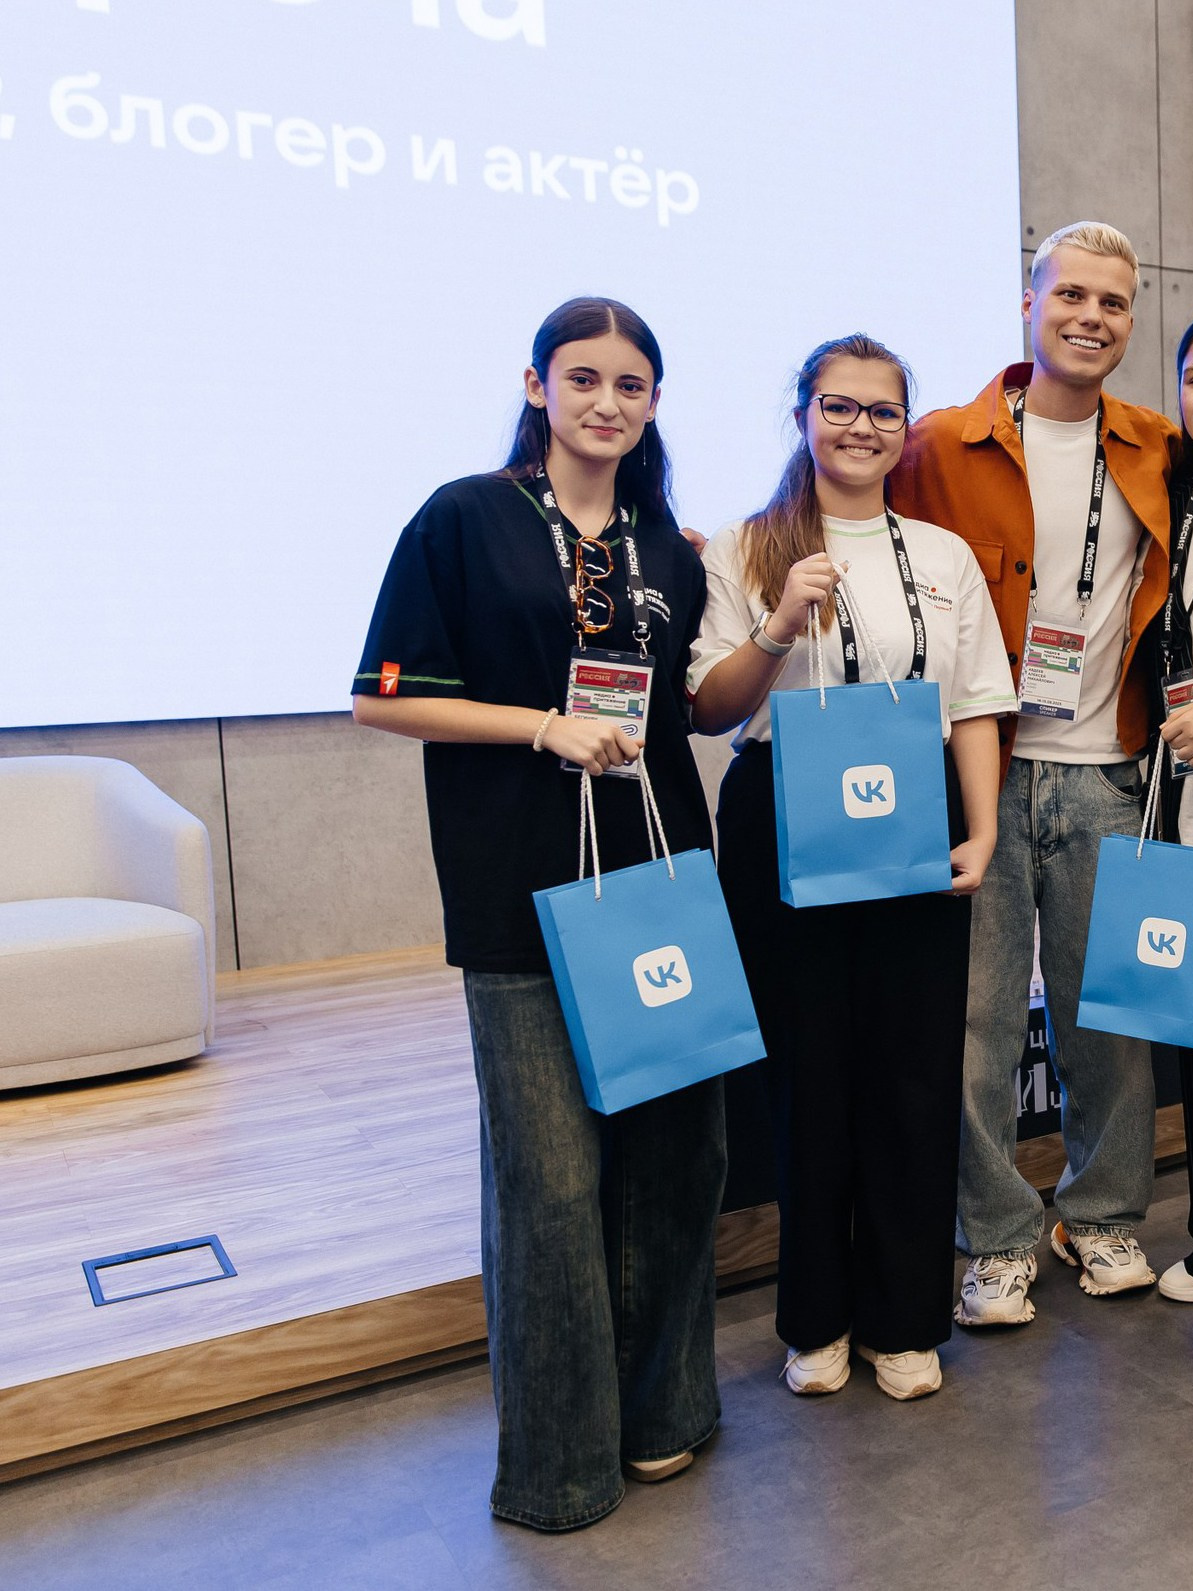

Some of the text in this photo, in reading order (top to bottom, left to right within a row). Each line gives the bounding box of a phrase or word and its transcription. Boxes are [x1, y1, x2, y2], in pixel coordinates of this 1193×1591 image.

[48, 72, 387, 189] блогер
[410, 133, 458, 185] и
[483, 144, 700, 227] актёр
[1093, 460, 1104, 498] РОССИЯ
[551, 523, 571, 568] РОССИЯ
[1177, 513, 1193, 550] РОССИЯ
[625, 536, 640, 577] РОССИЯ
[898, 550, 912, 583] РОССИЯ
[1083, 542, 1096, 581] РОССИЯ
[913, 618, 924, 656] РОССИЯ
[851, 780, 887, 803] VK
[1147, 930, 1177, 956] VK
[643, 961, 683, 988] VK
